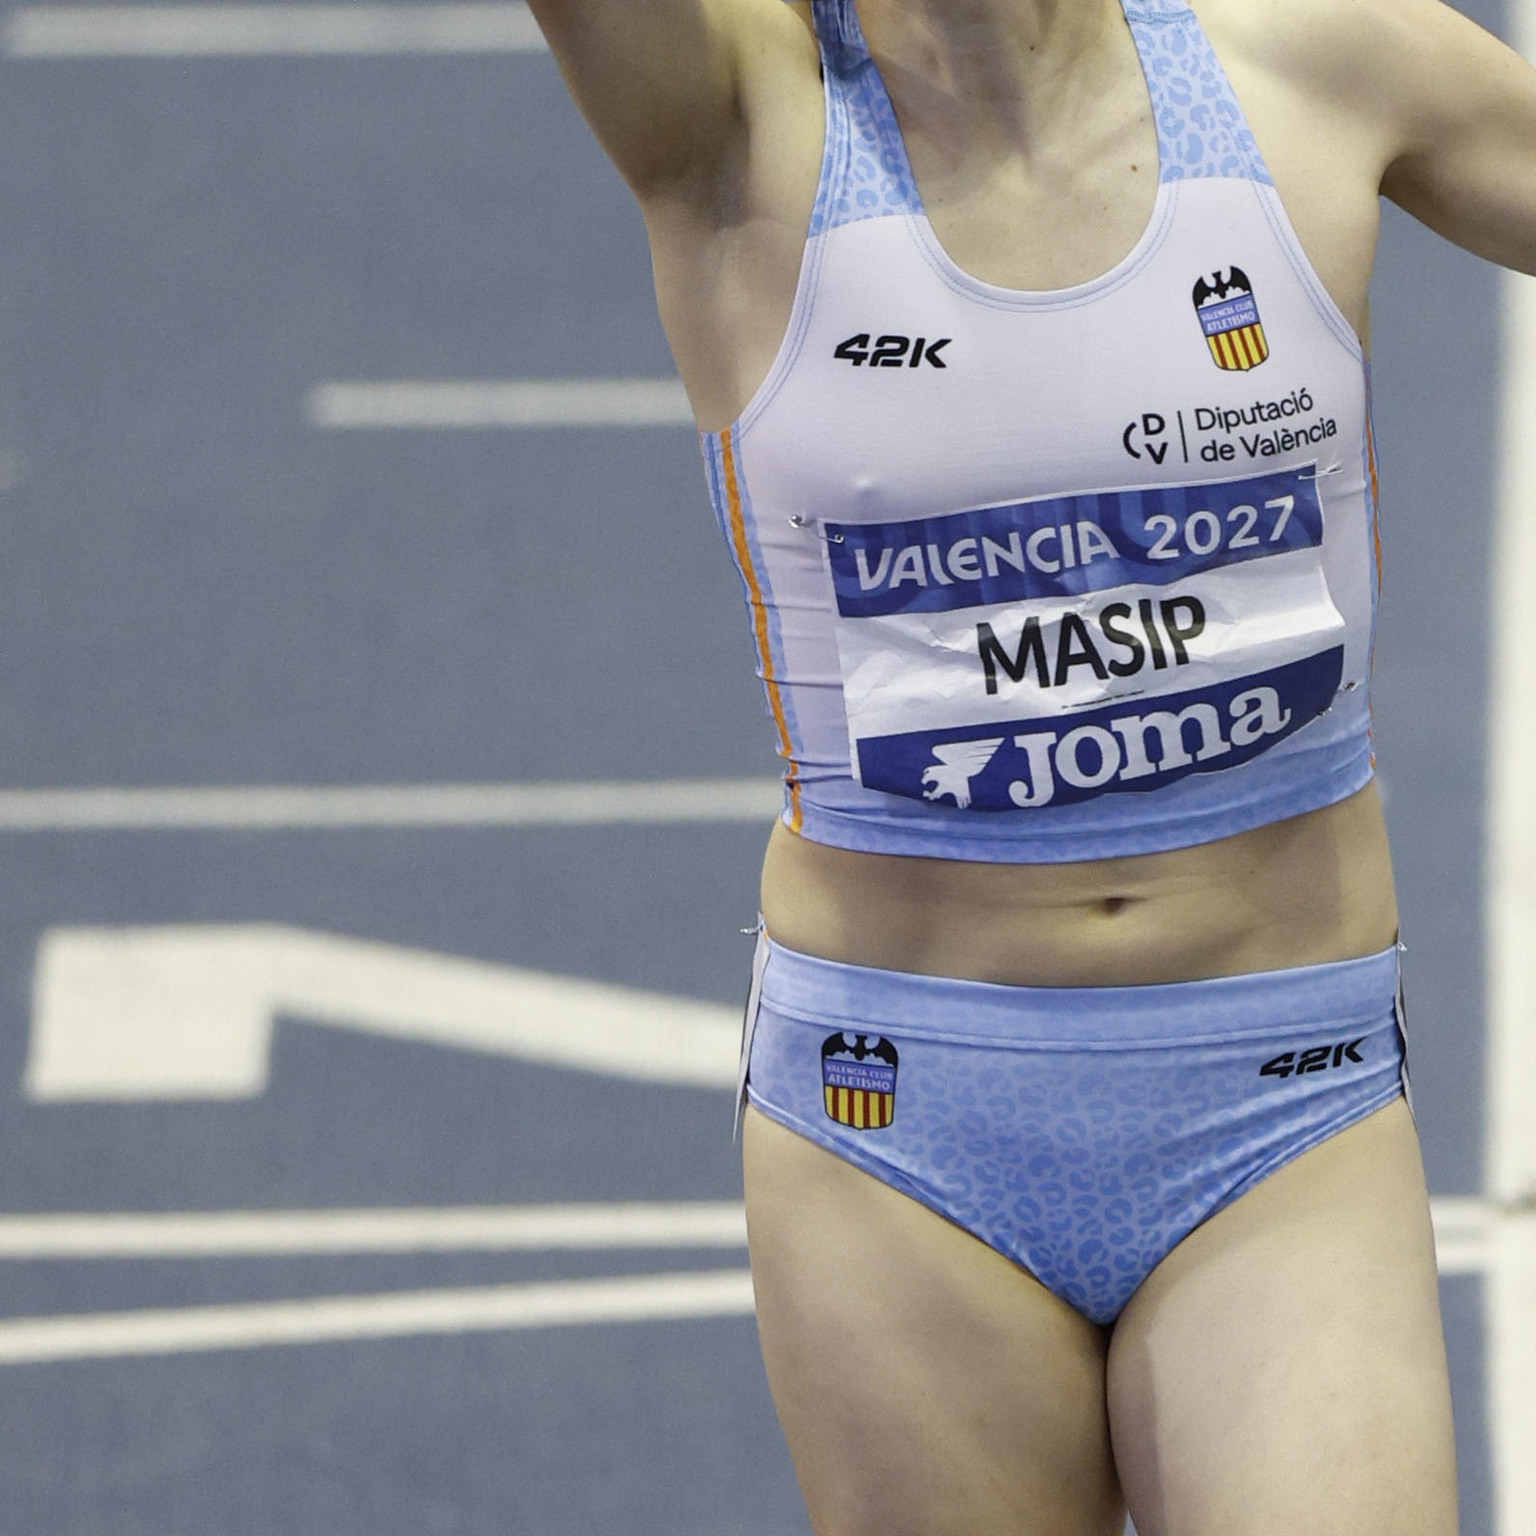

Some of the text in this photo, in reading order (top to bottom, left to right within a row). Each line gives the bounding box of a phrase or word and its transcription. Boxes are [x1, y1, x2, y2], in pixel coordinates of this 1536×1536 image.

[1206, 311, 1256, 332] ATLETISMO
[833, 333, 953, 369] 42K
[1194, 387, 1314, 435] Diputació
[1200, 417, 1338, 463] de València
[854, 494, 1297, 592] VALENCIA 2027
[976, 595, 1207, 696] MASIP
[1258, 1035, 1369, 1079] 42K
[828, 1073, 891, 1091] ATLETISMO
